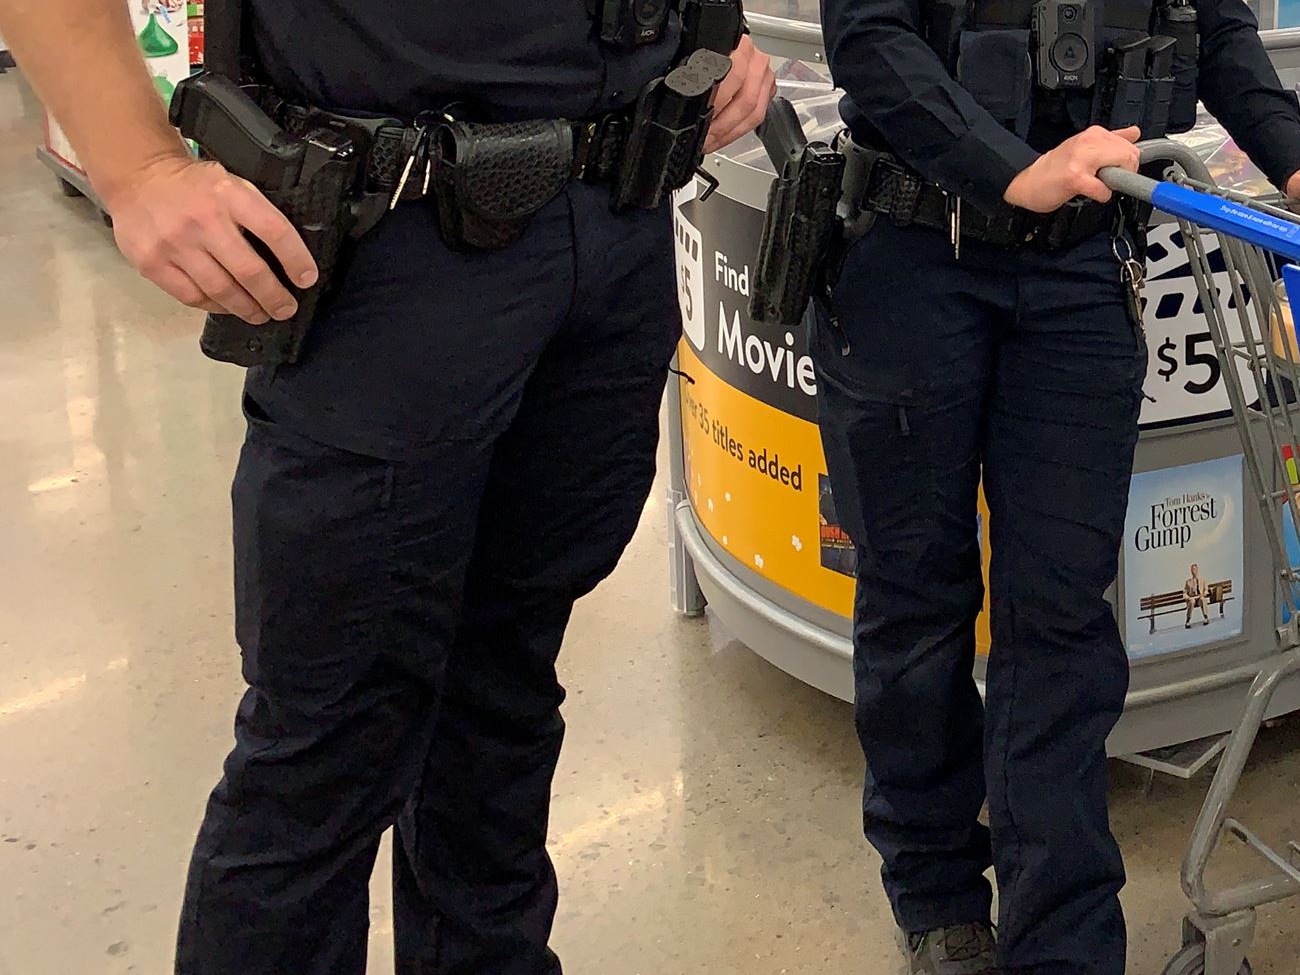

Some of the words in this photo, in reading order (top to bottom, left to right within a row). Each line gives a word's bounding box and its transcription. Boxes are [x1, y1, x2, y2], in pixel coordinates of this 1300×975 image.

[714, 250, 750, 298] Find
[717, 300, 818, 397] Movie
[1157, 331, 1222, 395] $5
[699, 403, 710, 435] 35
[712, 420, 744, 462] titles
[748, 448, 803, 492] added
[1134, 523, 1192, 553] Gump
[1151, 497, 1218, 531] Forrest
